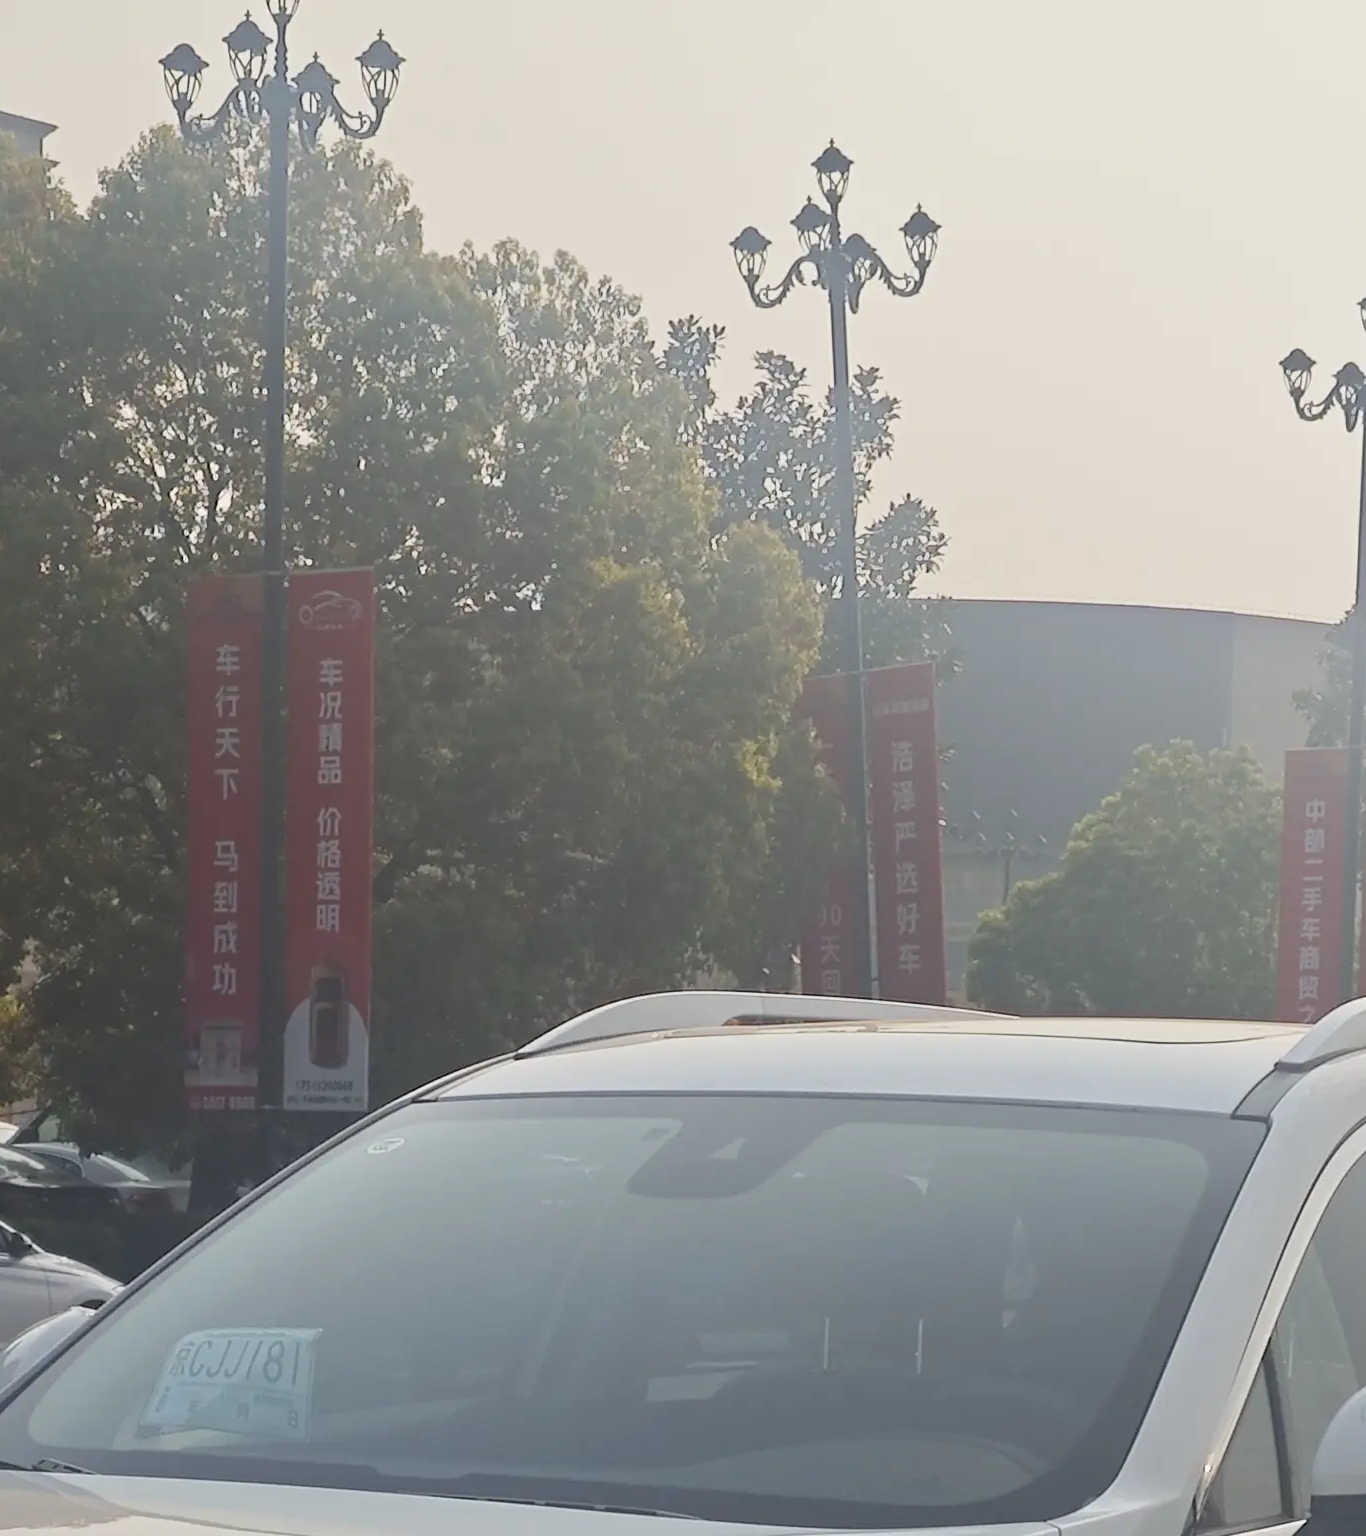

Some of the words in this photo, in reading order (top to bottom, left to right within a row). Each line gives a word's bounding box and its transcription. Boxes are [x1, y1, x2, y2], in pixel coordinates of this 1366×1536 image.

[214, 643, 241, 800] 车行天下
[317, 658, 344, 785] 车况精品
[212, 840, 240, 996] 马到成功
[316, 807, 342, 933] 价格透明
